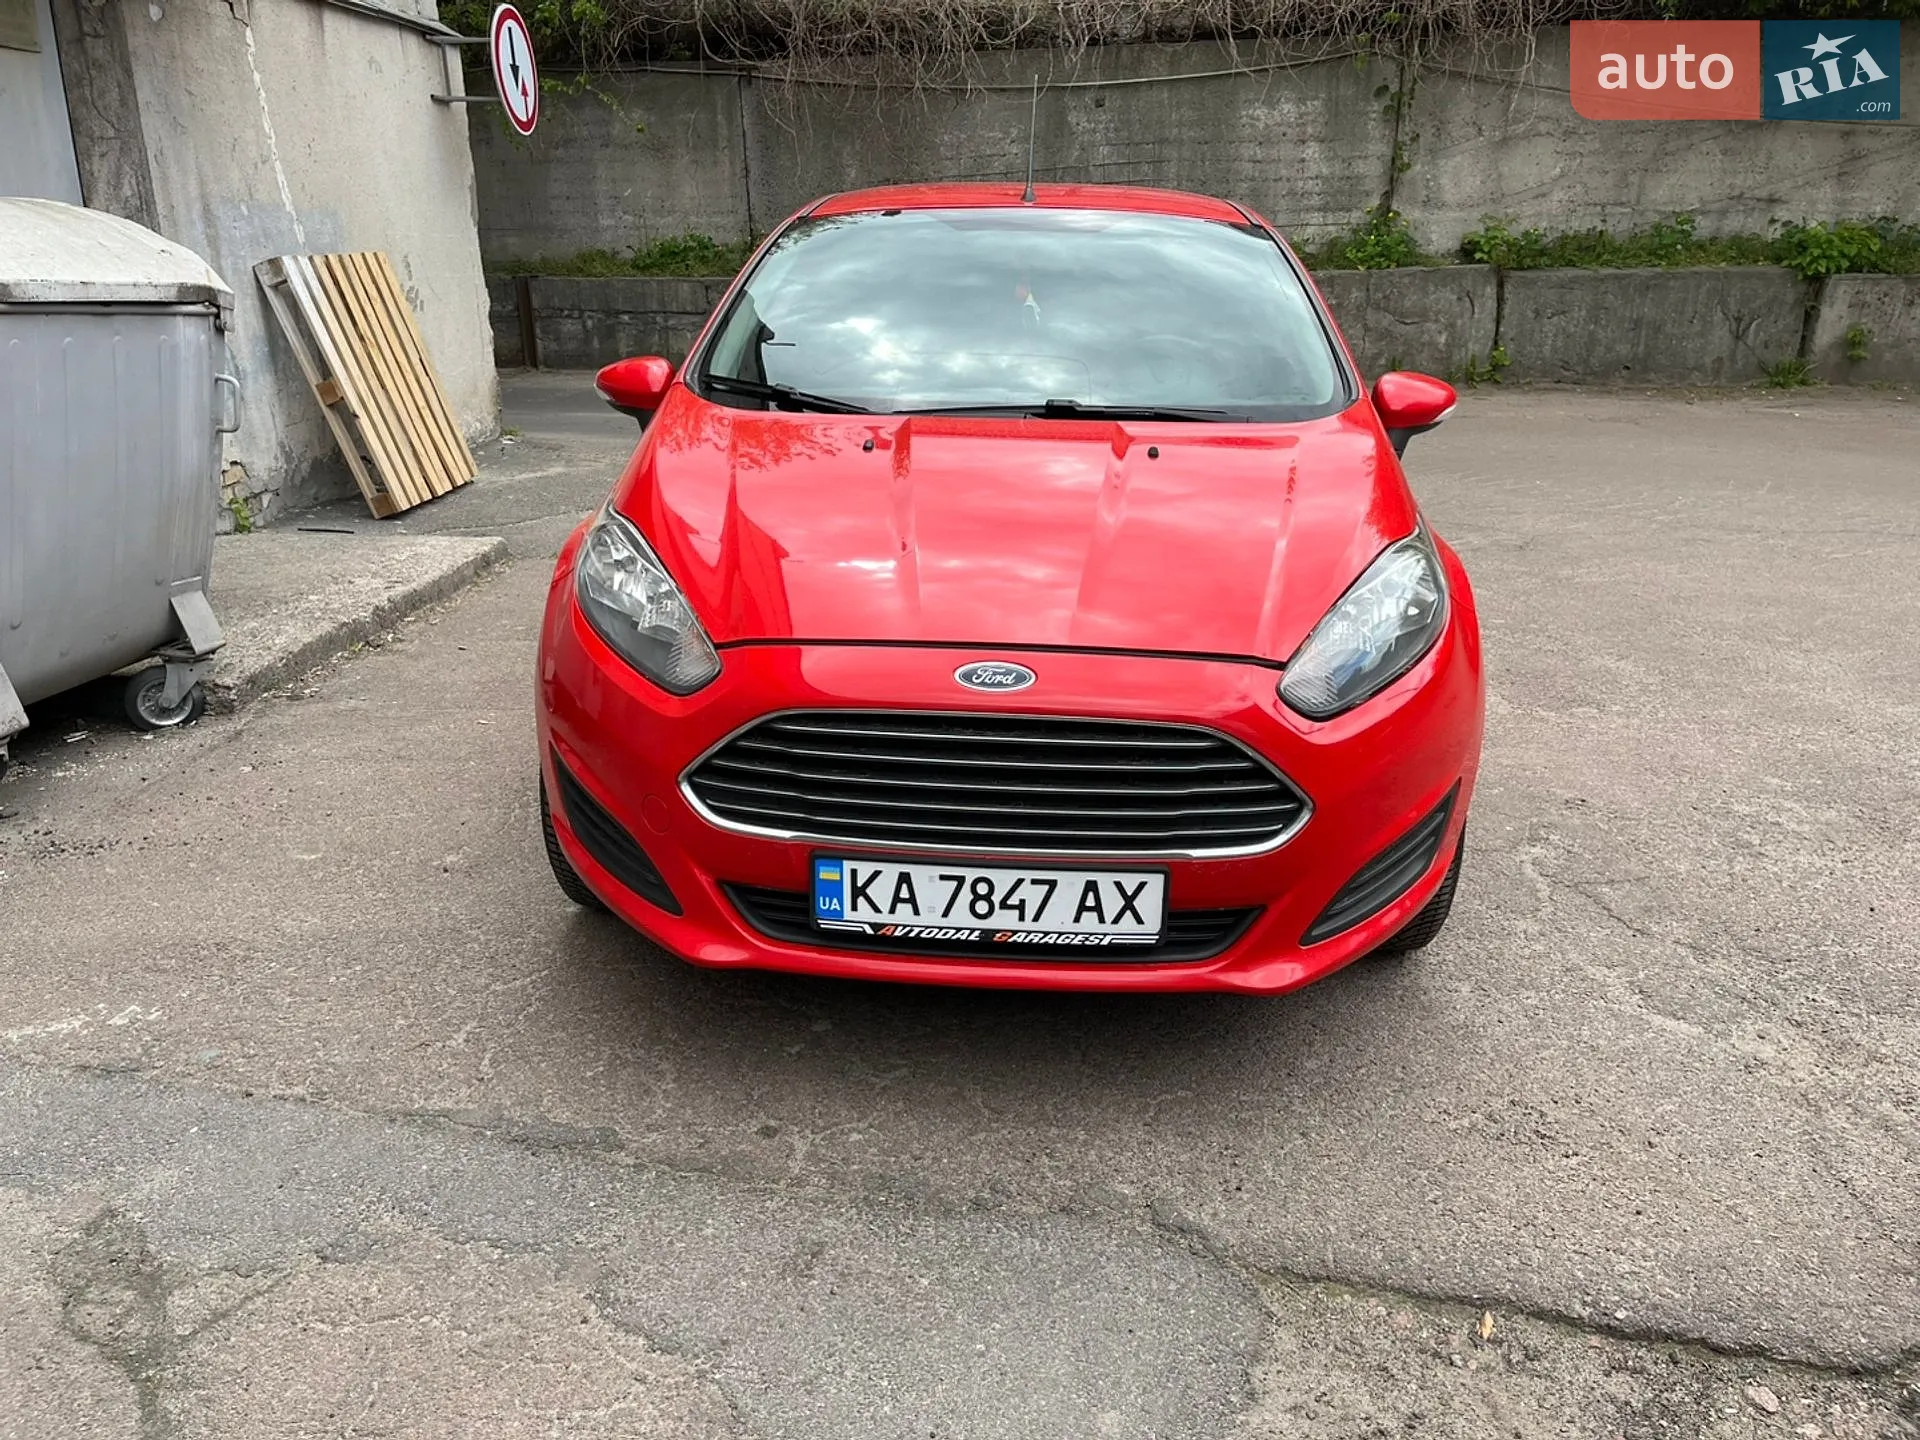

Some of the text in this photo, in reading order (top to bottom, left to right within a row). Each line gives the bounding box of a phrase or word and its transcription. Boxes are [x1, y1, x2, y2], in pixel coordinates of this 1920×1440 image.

[972, 666, 1017, 684] Ford
[819, 896, 841, 911] UA
[849, 867, 1148, 925] KA 7847 AX
[876, 925, 982, 941] AVTODAL
